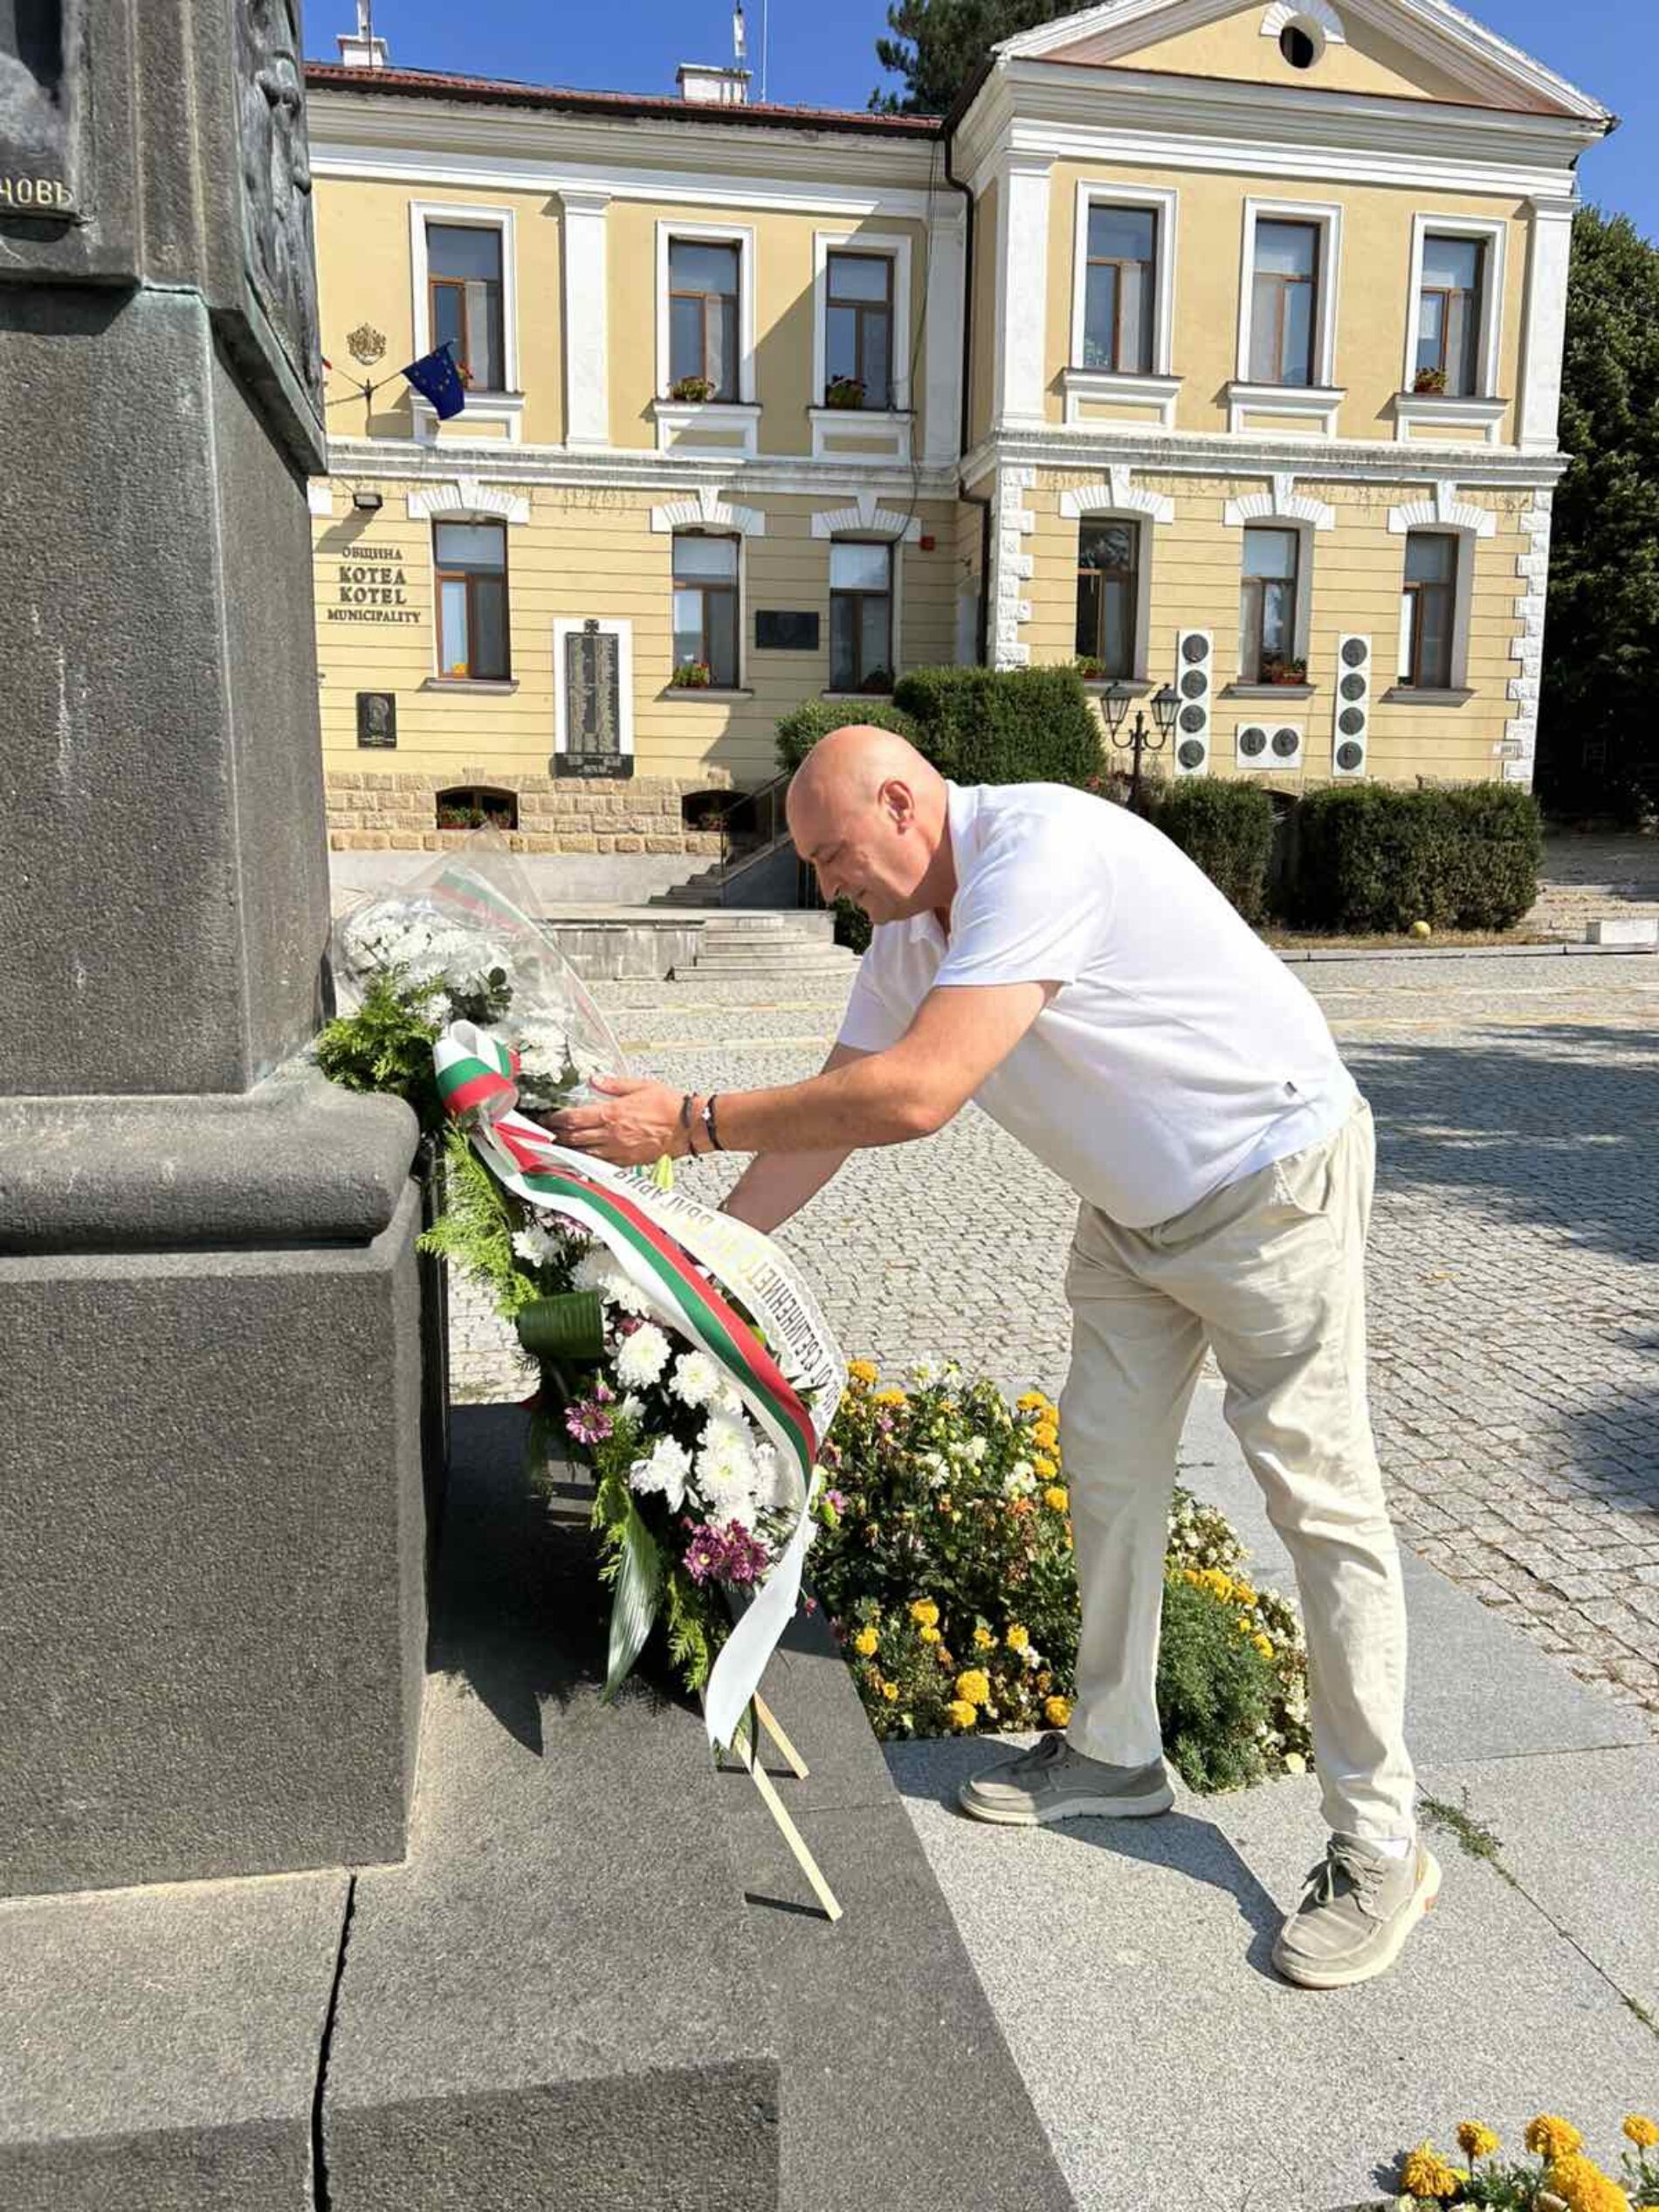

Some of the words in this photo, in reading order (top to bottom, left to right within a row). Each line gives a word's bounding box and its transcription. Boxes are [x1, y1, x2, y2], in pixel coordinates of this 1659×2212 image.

[342, 546, 403, 561] ОБЩИНА
[340, 586, 408, 604] KOTEL
[327, 608, 421, 624] MUNICIPALITY
